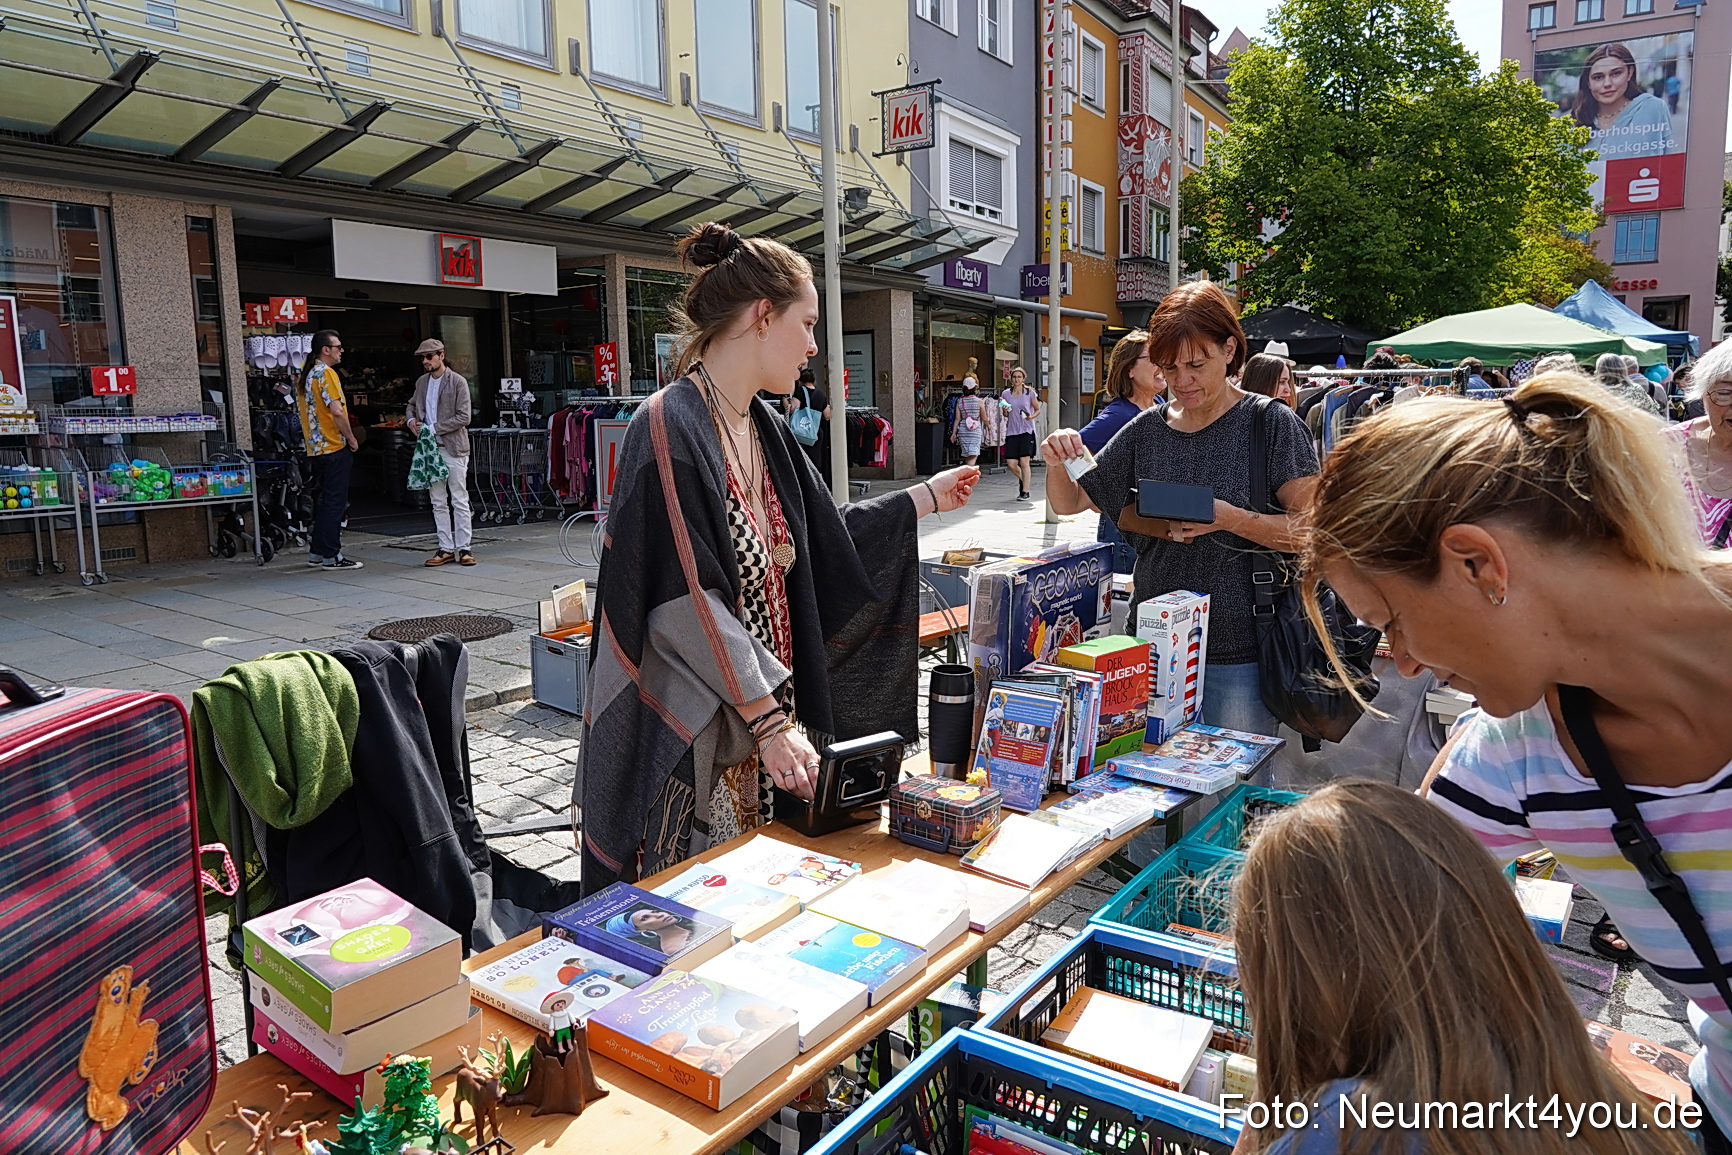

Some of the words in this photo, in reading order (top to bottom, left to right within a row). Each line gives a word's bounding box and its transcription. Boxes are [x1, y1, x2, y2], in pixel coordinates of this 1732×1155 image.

[892, 97, 924, 139] kik
[1587, 121, 1670, 139] berholspur.
[1600, 138, 1678, 155] Sackgasse.
[447, 243, 477, 278] kik
[955, 260, 982, 287] liberty
[1032, 556, 1099, 603] GEOMAG
[1068, 592, 1083, 604] world
[1138, 617, 1168, 631] puzzle
[1171, 605, 1191, 629] puzzle
[1103, 662, 1147, 683] JUGEND
[1107, 656, 1123, 671] DER
[1105, 678, 1134, 695] BROCK
[1104, 691, 1128, 708] HAUS
[574, 893, 640, 929] Tränenmond
[335, 926, 391, 950] SHADES
[355, 936, 393, 954] GREY
[477, 964, 503, 978] PER
[504, 936, 561, 965] NILSSON
[486, 969, 507, 983] SO
[510, 941, 569, 971] LONELY
[861, 950, 882, 965] unter
[863, 947, 901, 971] Fischen
[495, 1000, 507, 1010] SO
[638, 986, 681, 1015] CLANCY
[641, 990, 664, 1005] ANN
[647, 991, 712, 1033] Traumpfad
[676, 1017, 690, 1031] der
[690, 1005, 721, 1032] Liebe
[293, 1012, 317, 1037] SHADES
[630, 1049, 664, 1073] Traumpfad
[668, 1065, 697, 1084] CLANCY
[673, 1074, 690, 1087] ANN
